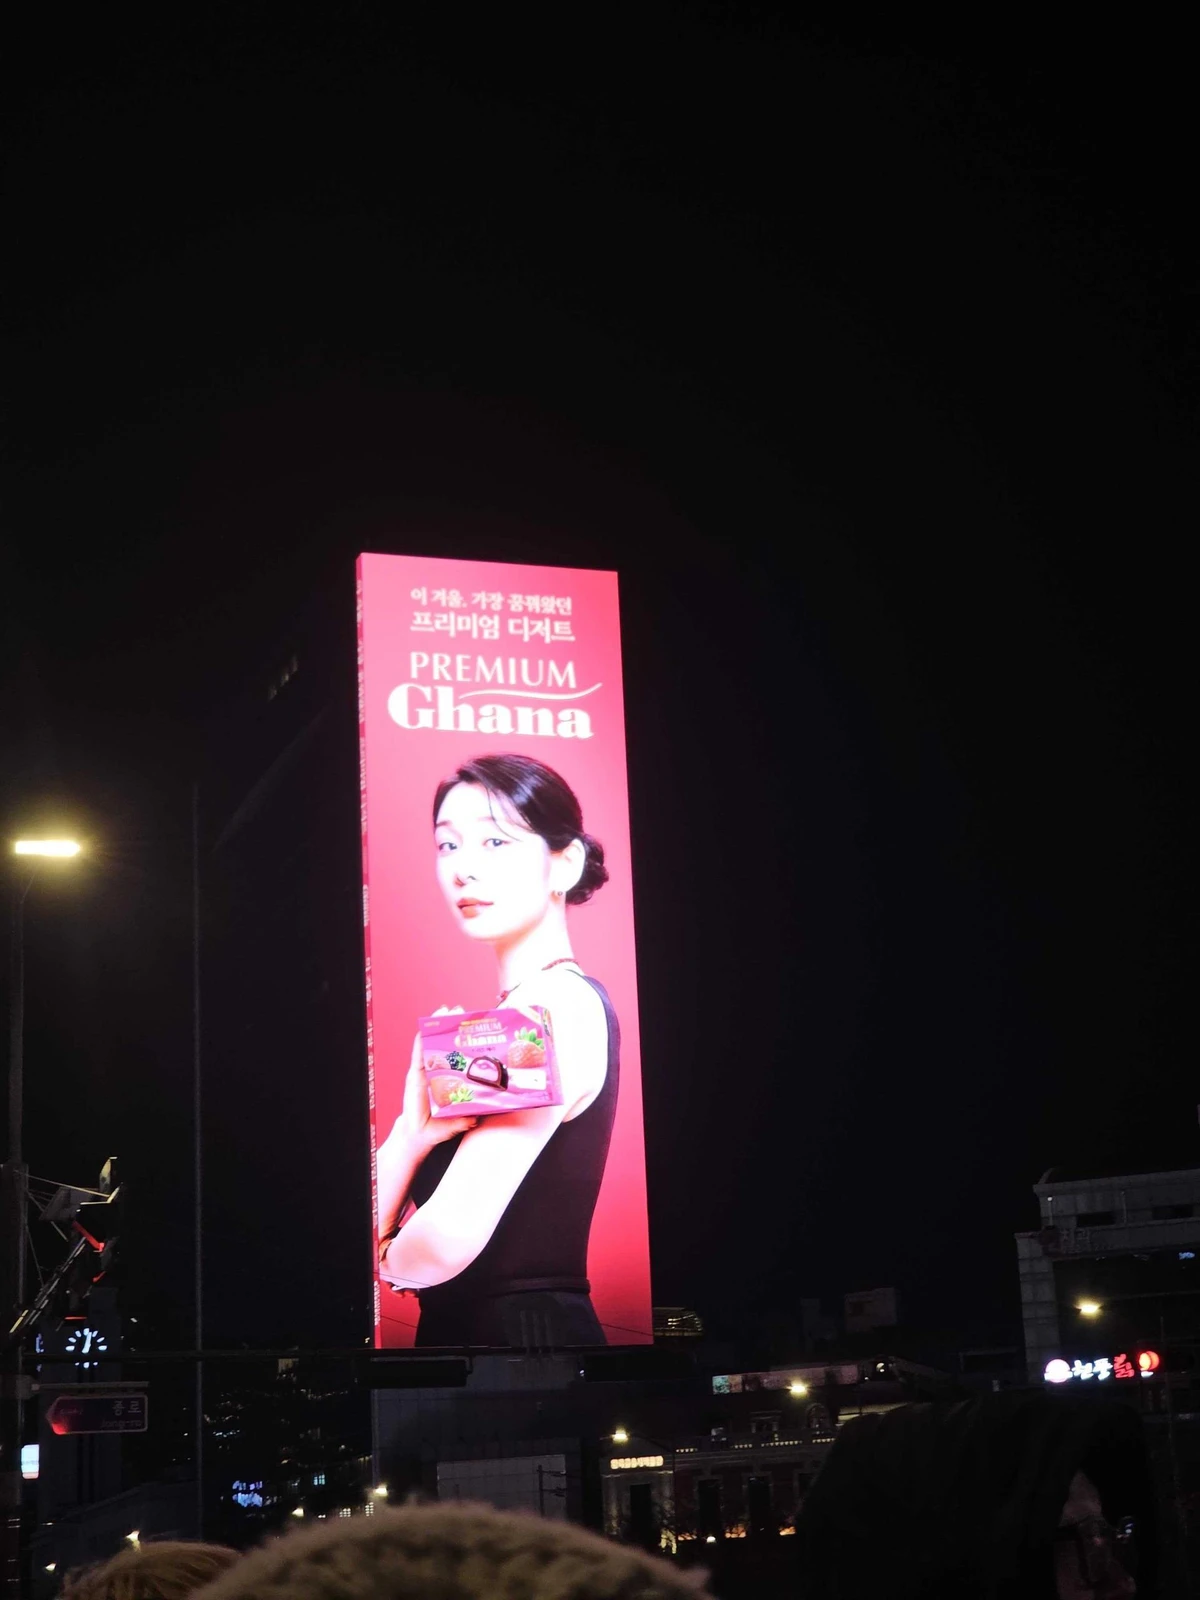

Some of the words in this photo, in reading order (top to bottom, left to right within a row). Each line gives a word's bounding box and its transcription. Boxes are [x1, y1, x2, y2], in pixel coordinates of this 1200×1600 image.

[410, 587, 427, 606] 이
[472, 591, 504, 611] 가장
[410, 611, 500, 640] 프리미엄
[508, 616, 576, 644] 디저트
[410, 651, 577, 689] PREMIUM
[387, 683, 594, 740] Ghana
